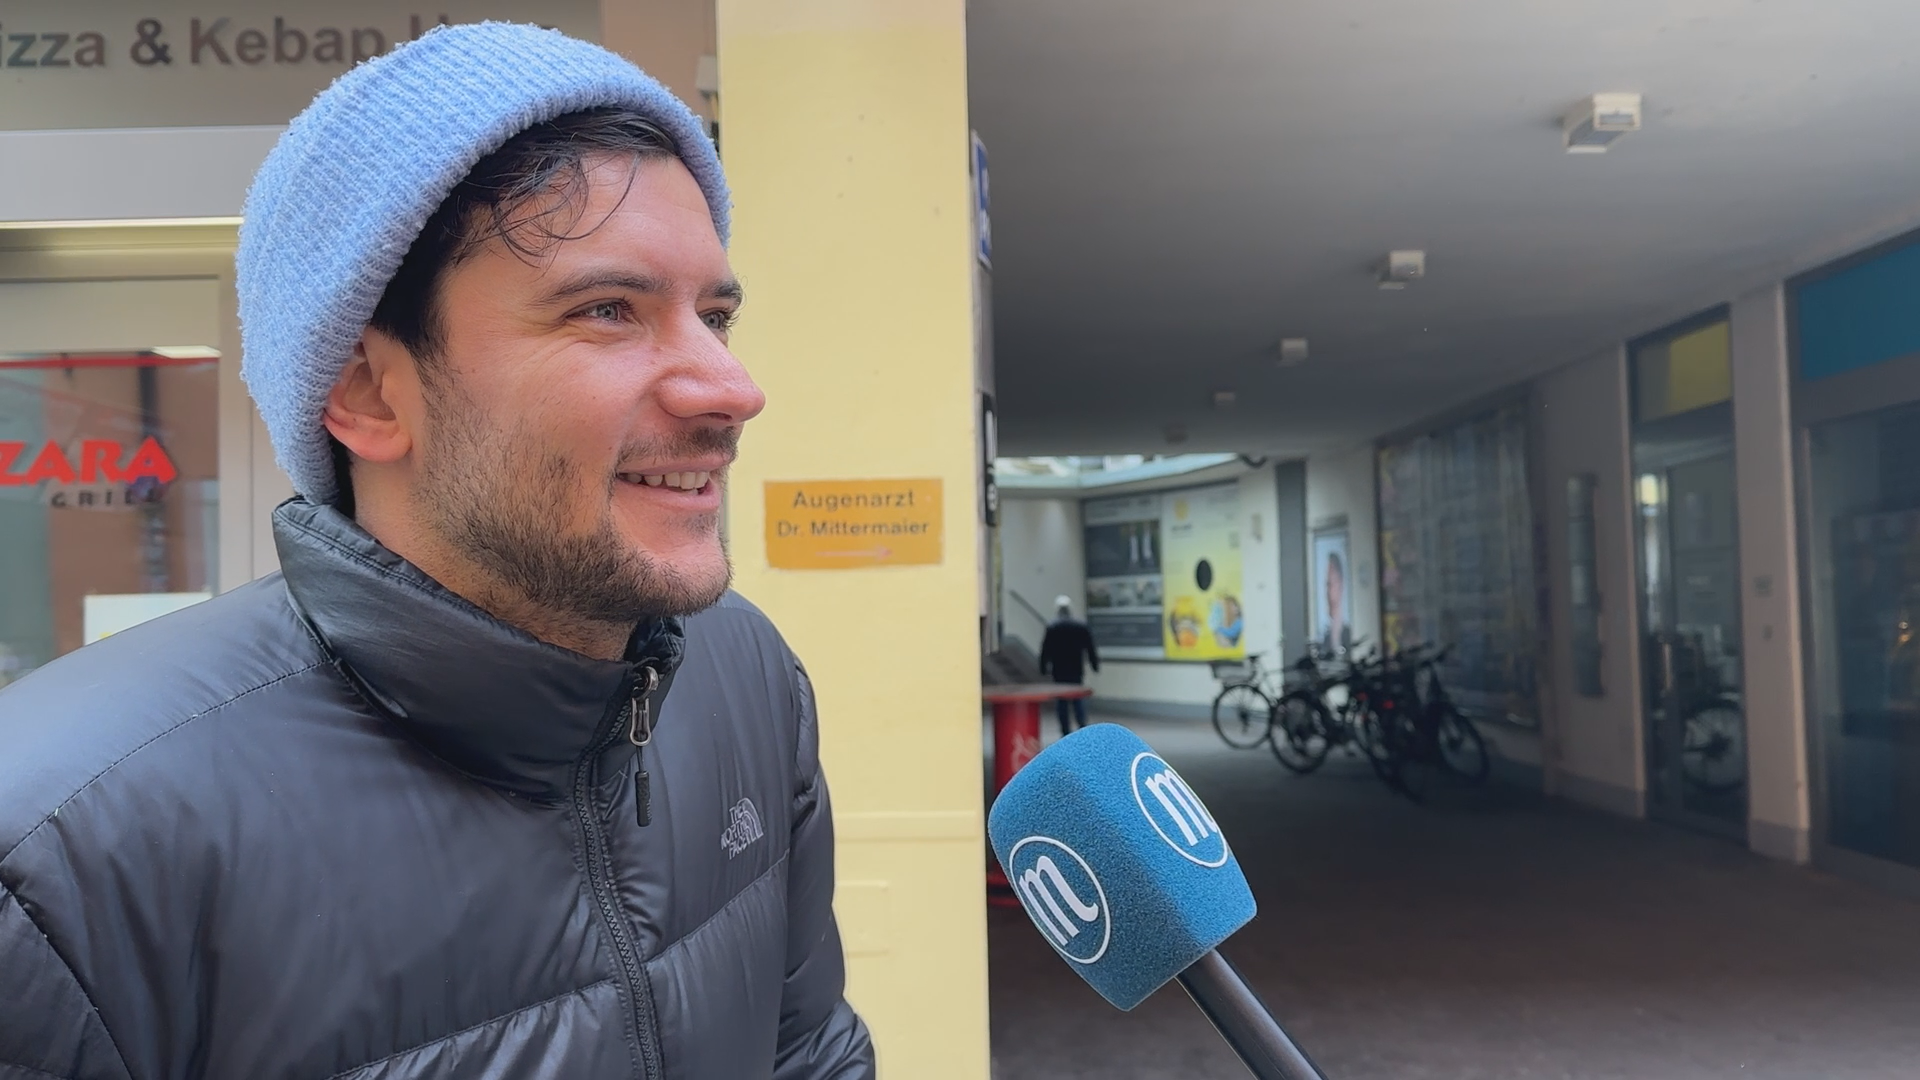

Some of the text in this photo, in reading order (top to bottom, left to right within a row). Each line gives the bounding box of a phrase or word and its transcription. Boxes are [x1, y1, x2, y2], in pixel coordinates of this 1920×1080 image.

[0, 23, 106, 68] zza
[130, 17, 172, 67] &
[190, 16, 386, 70] Kebap
[793, 489, 915, 511] Augenarzt
[776, 518, 930, 537] Dr. Mittermaier
